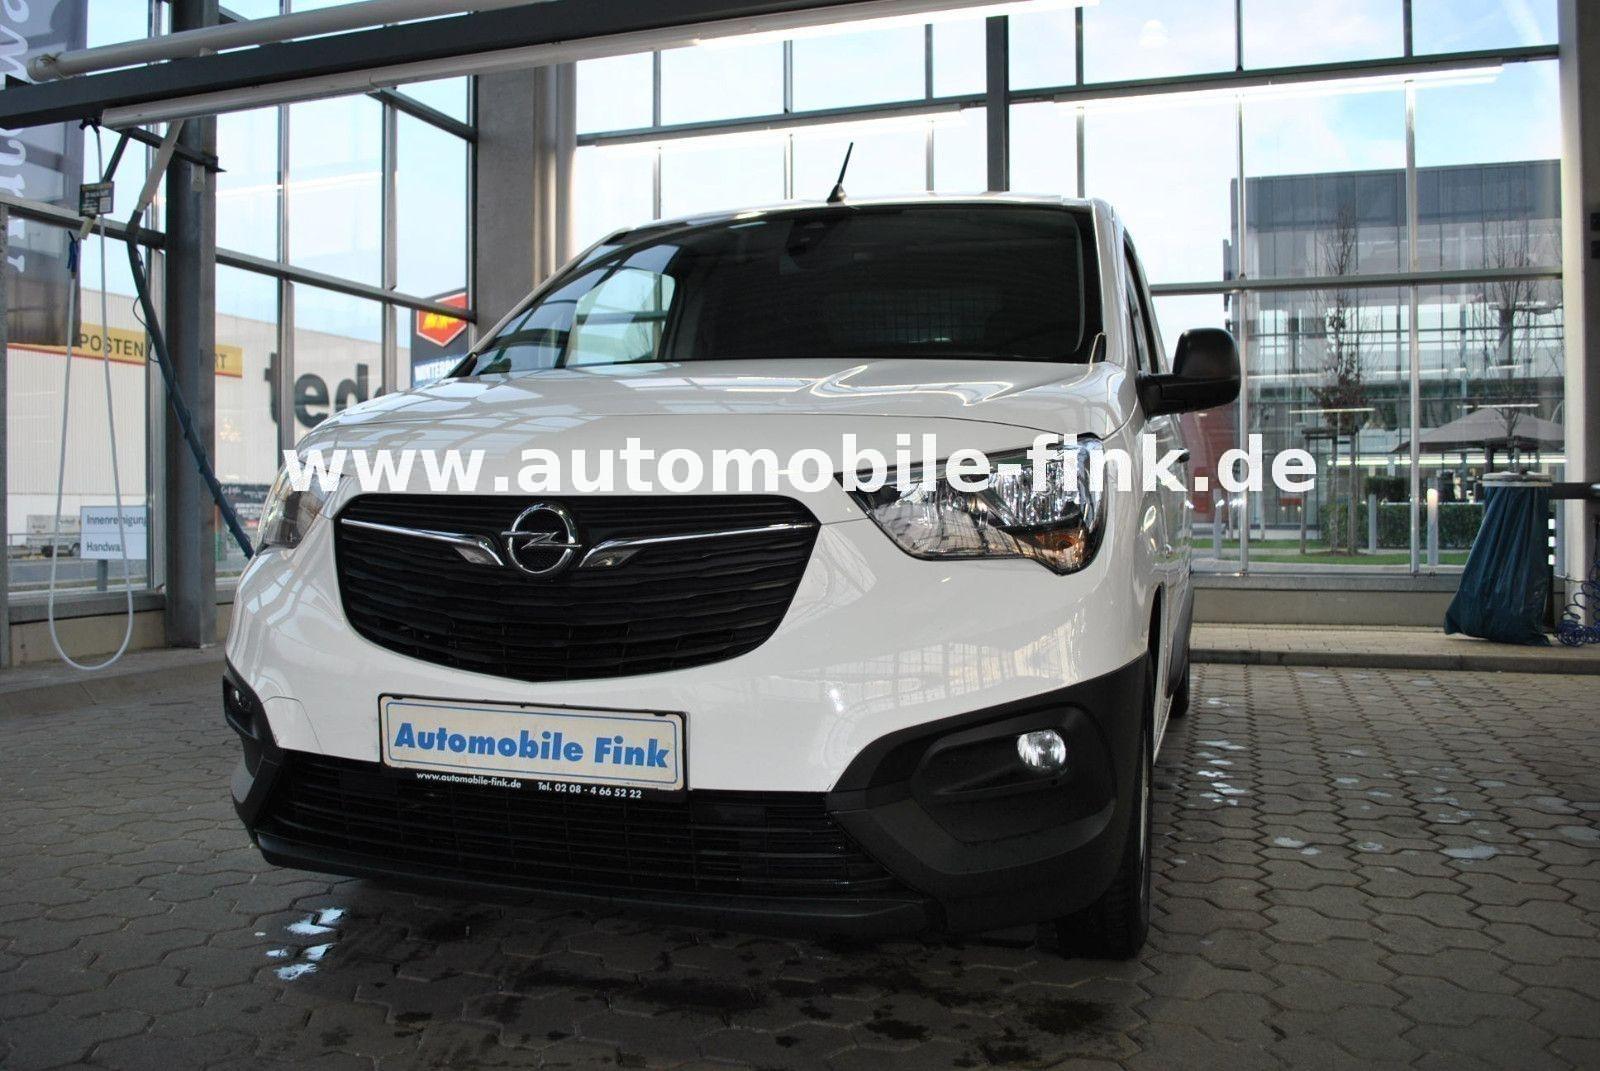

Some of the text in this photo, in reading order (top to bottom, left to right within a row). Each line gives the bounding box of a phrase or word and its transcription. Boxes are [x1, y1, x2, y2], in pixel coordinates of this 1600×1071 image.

[394, 722, 670, 768] Automobile Fink
[416, 771, 522, 789] www.automobile-fink.de
[538, 781, 552, 792] Tel.
[554, 783, 567, 793] 02
[569, 784, 582, 794] 08
[590, 786, 597, 795] 4
[599, 787, 612, 797] 66
[614, 788, 627, 798] 52
[629, 789, 642, 799] 22
